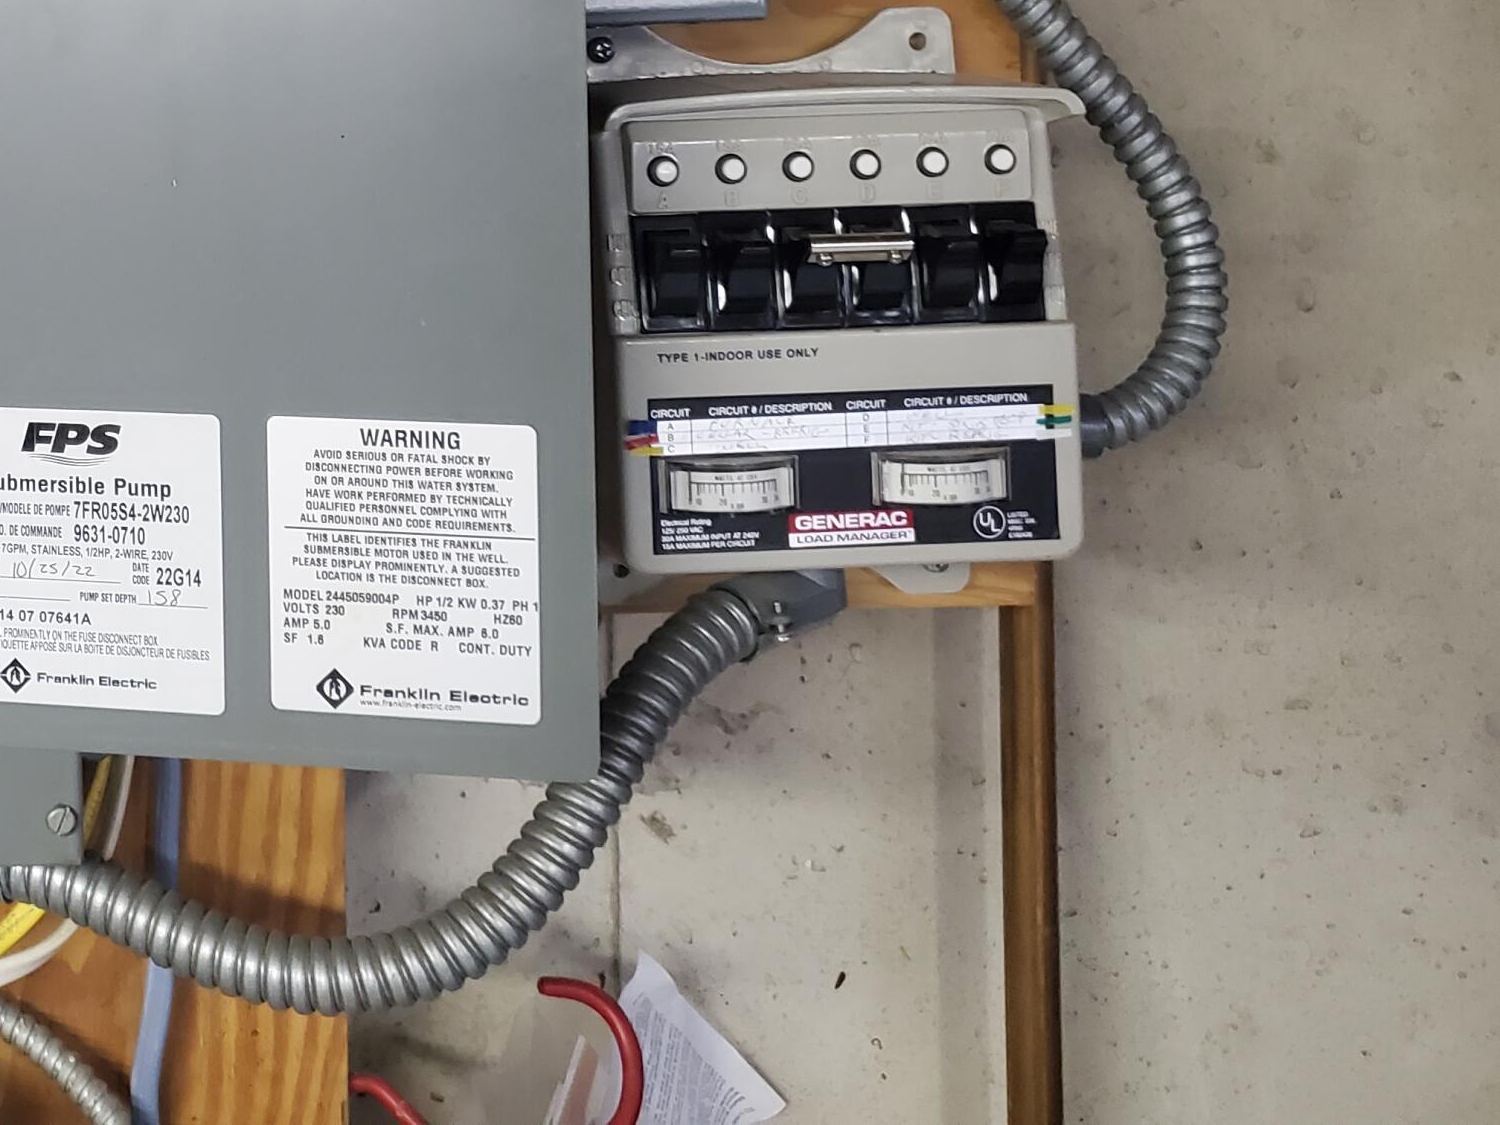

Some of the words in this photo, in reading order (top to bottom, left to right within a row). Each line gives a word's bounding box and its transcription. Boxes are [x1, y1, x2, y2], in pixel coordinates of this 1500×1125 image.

[657, 353, 690, 364] TYPE
[694, 350, 754, 362] 1-INDOOR
[758, 349, 783, 361] USE
[786, 347, 819, 359] ONLY
[846, 399, 886, 410] CIRCUIT
[903, 397, 944, 407] CIRCUIT
[960, 393, 1028, 404] DESCRIPTION
[650, 408, 690, 419] CIRCUIT
[708, 406, 749, 417] CIRCUIT
[765, 402, 832, 413] DESCRIPTION
[863, 425, 869, 433] E
[21, 422, 121, 455] FPS
[360, 428, 461, 450] WARNING
[314, 450, 342, 459] AVOID
[346, 451, 387, 461] SERIOUS
[391, 453, 404, 462] OR
[408, 453, 437, 464] FATAL
[442, 455, 474, 465] SHOCK
[478, 457, 490, 466] BY
[114, 478, 171, 501] Pump
[34, 503, 44, 515] DE
[45, 504, 71, 517] POMPE
[74, 501, 189, 523] 7FR05S4-2W230
[795, 512, 907, 530] GENERAC
[9, 526, 18, 536] DE
[21, 526, 62, 538] COMMANDE
[74, 525, 145, 545] 9631-0710
[797, 535, 833, 544] LOAD
[843, 531, 906, 541] MANAGER
[1, 543, 29, 556] 7GPM,
[31, 545, 83, 558] STAINLESS,
[86, 546, 112, 560] 1/2HP,
[115, 548, 149, 561] 2-WIRE,
[152, 550, 173, 561] 230V
[132, 562, 149, 573] DATE
[132, 575, 149, 585] CODE
[156, 568, 201, 587] 22G14
[80, 592, 99, 602] PUMP
[101, 593, 113, 602] SET
[115, 593, 136, 604] DEPTH
[284, 589, 323, 601] MODEL
[326, 591, 399, 604] 2445059004P
[283, 603, 319, 614] VOLTS
[326, 605, 345, 615] 230
[19, 610, 33, 621] 07
[39, 610, 91, 625] 07641A
[393, 609, 418, 620] RPM
[421, 610, 447, 622] 3450
[494, 614, 522, 626] HZ60
[37, 673, 94, 686] Franklin
[99, 676, 156, 689] Electric
[360, 685, 440, 701] Franklin
[450, 690, 529, 706] Electric
